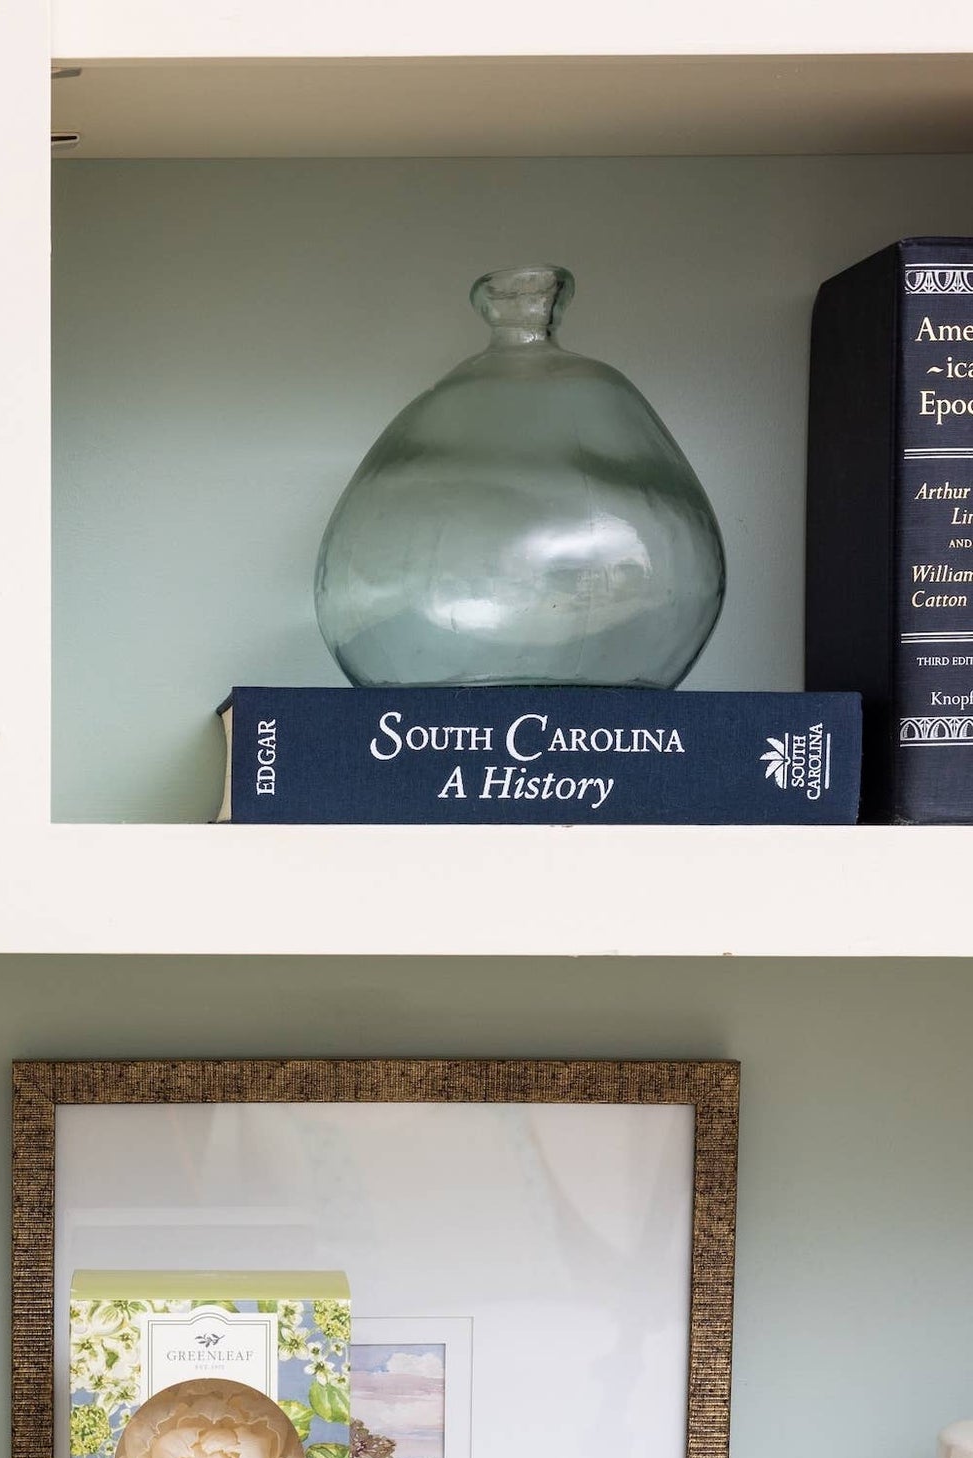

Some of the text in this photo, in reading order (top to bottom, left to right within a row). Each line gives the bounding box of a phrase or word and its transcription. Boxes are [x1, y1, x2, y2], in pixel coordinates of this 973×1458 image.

[915, 316, 973, 342] Ame
[915, 481, 971, 500] Arthur
[949, 538, 973, 548] AND
[911, 590, 968, 608] Catton
[916, 656, 950, 666] THIRD
[931, 689, 973, 711] Knopf
[256, 719, 276, 796] EDGAR
[791, 735, 807, 788] SOUTH
[807, 722, 824, 801] CAROLINA
[437, 765, 615, 809] A History
[166, 1350, 254, 1361] GREENLEAF
